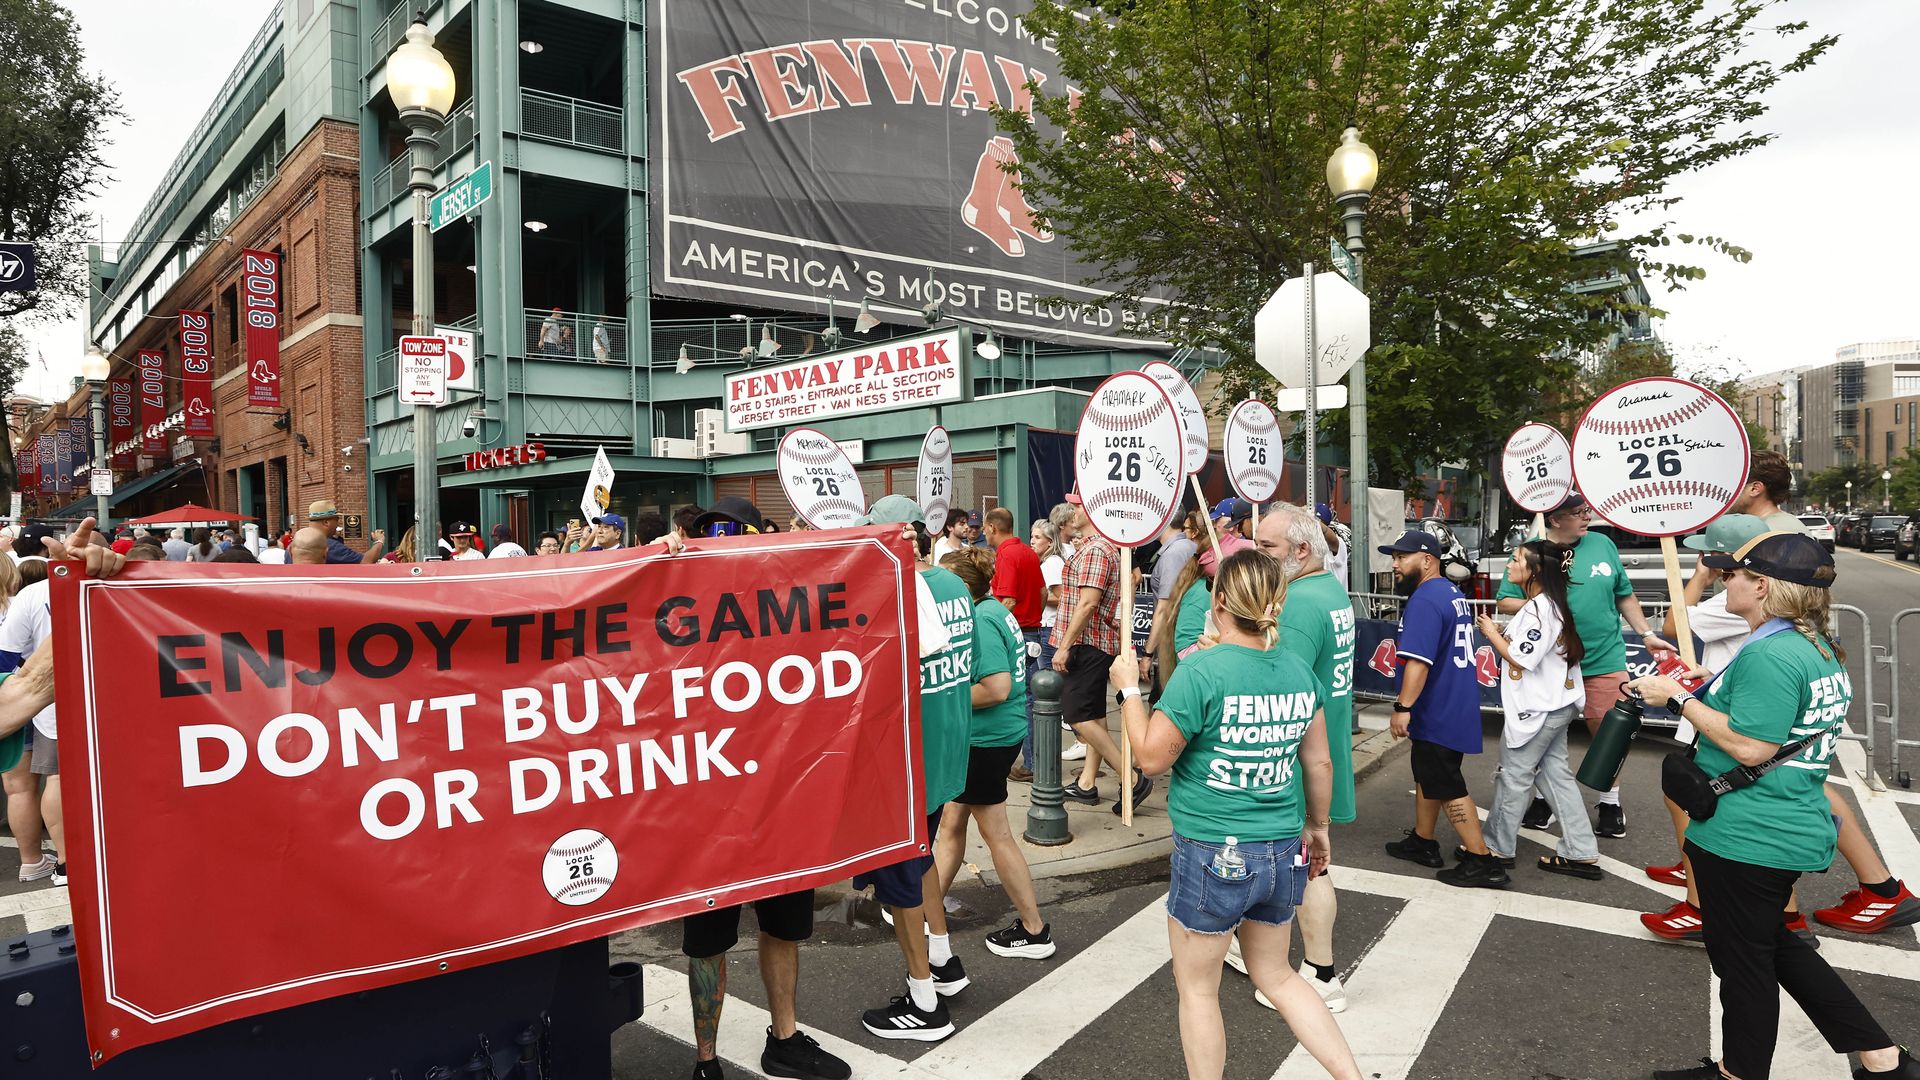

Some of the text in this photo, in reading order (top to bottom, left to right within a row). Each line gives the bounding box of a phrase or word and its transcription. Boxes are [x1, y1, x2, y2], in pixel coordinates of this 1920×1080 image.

[677, 38, 1047, 143] FENWAY
[439, 180, 472, 224] JERSEY
[682, 240, 886, 296] AMERICA'S
[899, 275, 986, 308] MOST
[246, 255, 277, 329] 2018
[182, 314, 209, 374] 2013
[404, 342, 443, 354] TOW ZONE
[414, 357, 432, 366] NO
[731, 339, 952, 401] FENWAY PARK
[140, 353, 164, 408] 2007
[730, 367, 955, 414] GATE D STAIRS ENTRANCE ALL SECTIONS
[112, 382, 132, 427] 2004
[738, 384, 942, 424] JERSEY STREET VAN NESS STREET
[1101, 388, 1147, 407] ARAMARK
[1617, 391, 1673, 409] Aramark
[57, 431, 72, 463] 1967
[70, 419, 87, 453] 1975
[1105, 436, 1146, 449] LOCAL
[1247, 436, 1268, 446] LOCAL
[1618, 434, 1684, 452] LOCAL
[462, 444, 541, 471] TICKETS
[1248, 446, 1267, 466] 26
[1520, 453, 1548, 466] LOCAL
[1586, 439, 1725, 461] on Strike
[805, 467, 837, 476] LOCAL
[930, 466, 944, 475] LOCAL
[1107, 452, 1141, 483] 26
[1146, 445, 1177, 489] STRIKE
[1525, 462, 1549, 482] 26
[1626, 449, 1683, 480] 26
[812, 477, 841, 497] 26
[931, 476, 943, 496] 26
[1105, 508, 1143, 521] UNITEHERE!
[1631, 501, 1694, 514] UNITEHERE!
[936, 596, 971, 623] WAY
[157, 582, 869, 698] ENJOY THE GAME.
[1453, 623, 1477, 668] 50
[178, 649, 863, 788] DON'T BUY FOOD
[1221, 691, 1316, 724] FENWAY
[1263, 746, 1284, 758] ON
[359, 727, 759, 841] OR DRINK.
[1207, 754, 1297, 788] STRIK
[565, 854, 595, 866] LOCAL
[569, 862, 594, 880] 26
[1010, 938, 1029, 948] HOKA
